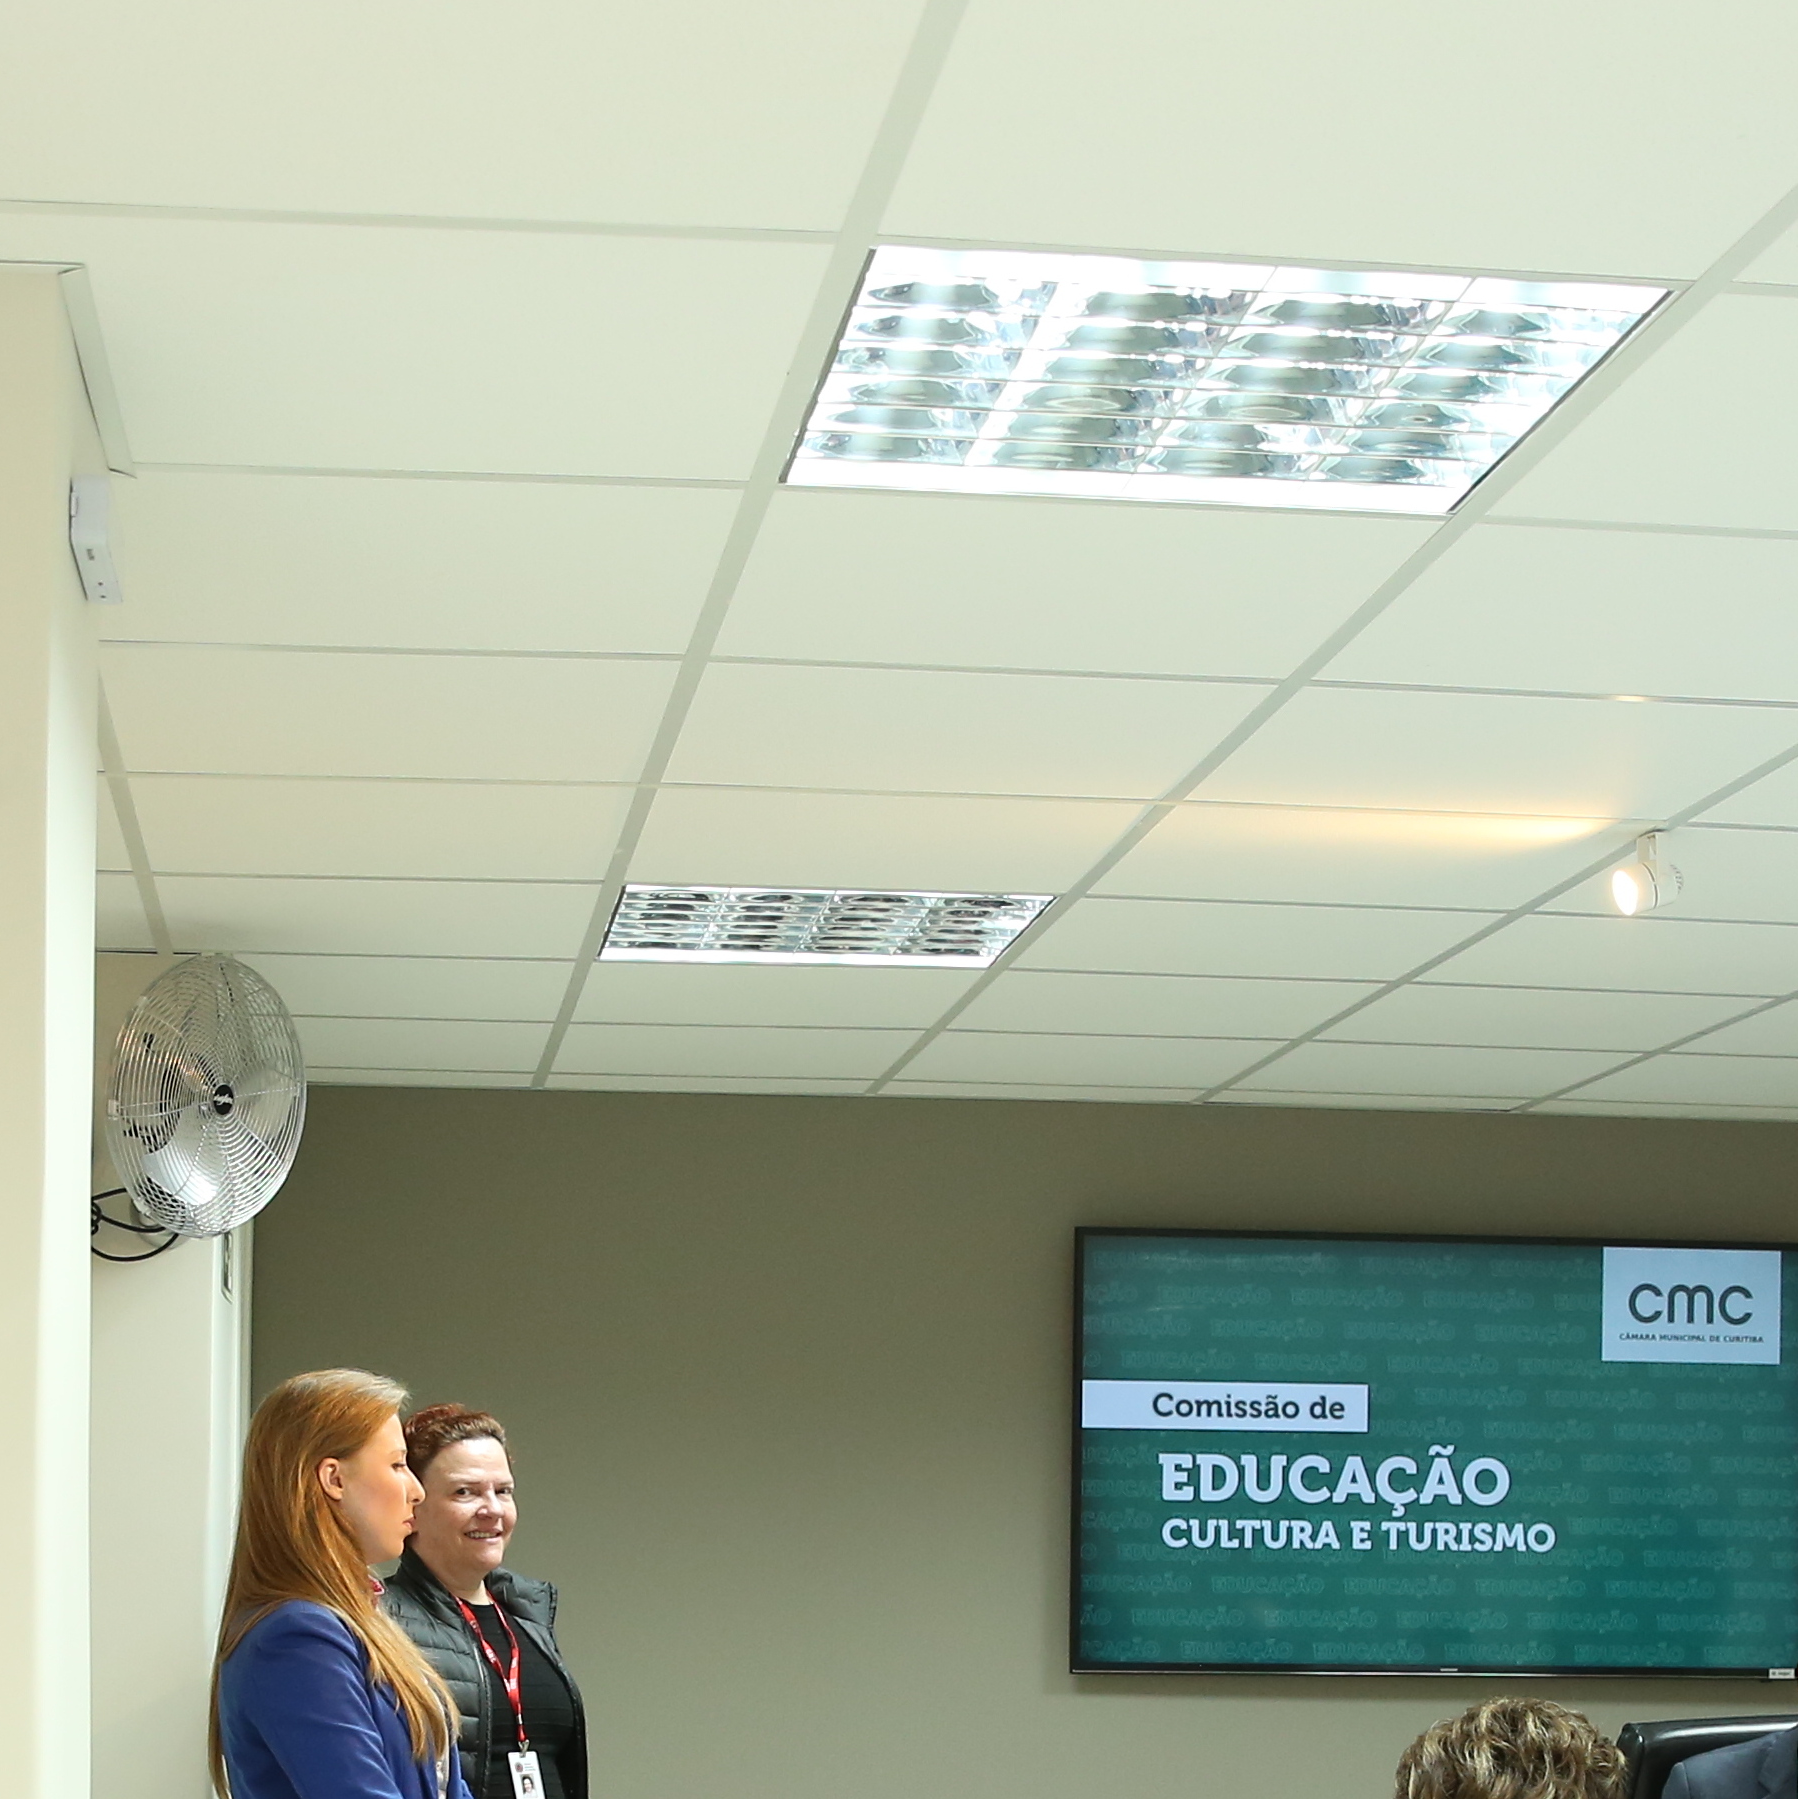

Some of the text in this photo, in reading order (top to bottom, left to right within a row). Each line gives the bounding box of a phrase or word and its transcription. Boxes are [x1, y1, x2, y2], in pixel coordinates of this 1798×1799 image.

[1628, 1283, 1754, 1326] cmc
[1659, 1333, 1707, 1343] MUNICIPAL
[1709, 1334, 1721, 1343] DE
[1152, 1392, 1346, 1420] Comissão de
[1158, 1445, 1511, 1518] EDUCAÇÃO
[1161, 1516, 1557, 1553] CULTURA E TURISMO
